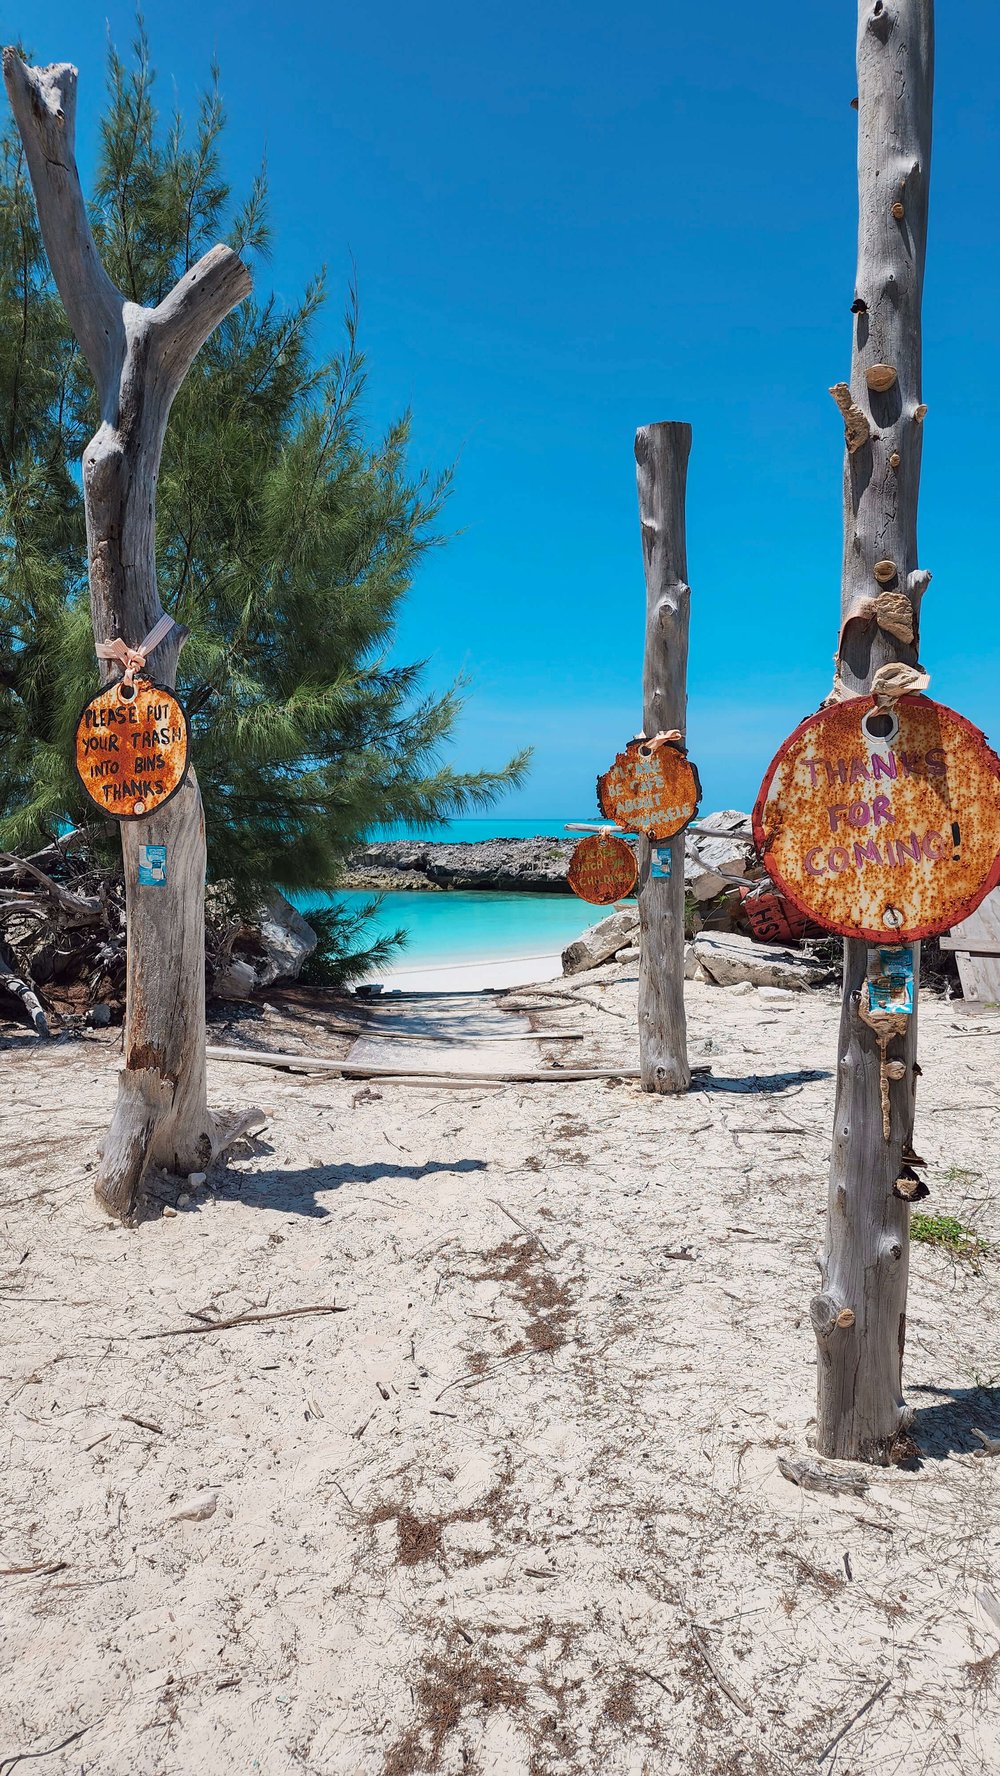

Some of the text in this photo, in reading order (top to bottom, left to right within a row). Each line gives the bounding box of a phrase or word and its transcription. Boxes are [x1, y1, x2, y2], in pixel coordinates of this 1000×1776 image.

[85, 704, 169, 728] PLEASE PUT
[82, 727, 181, 756] YOUR TRASH
[90, 754, 166, 778] INTO BINS
[800, 748, 947, 787] THANKS
[608, 783, 624, 797] BE
[616, 793, 662, 814] ABOUT
[827, 795, 896, 832] FOR
